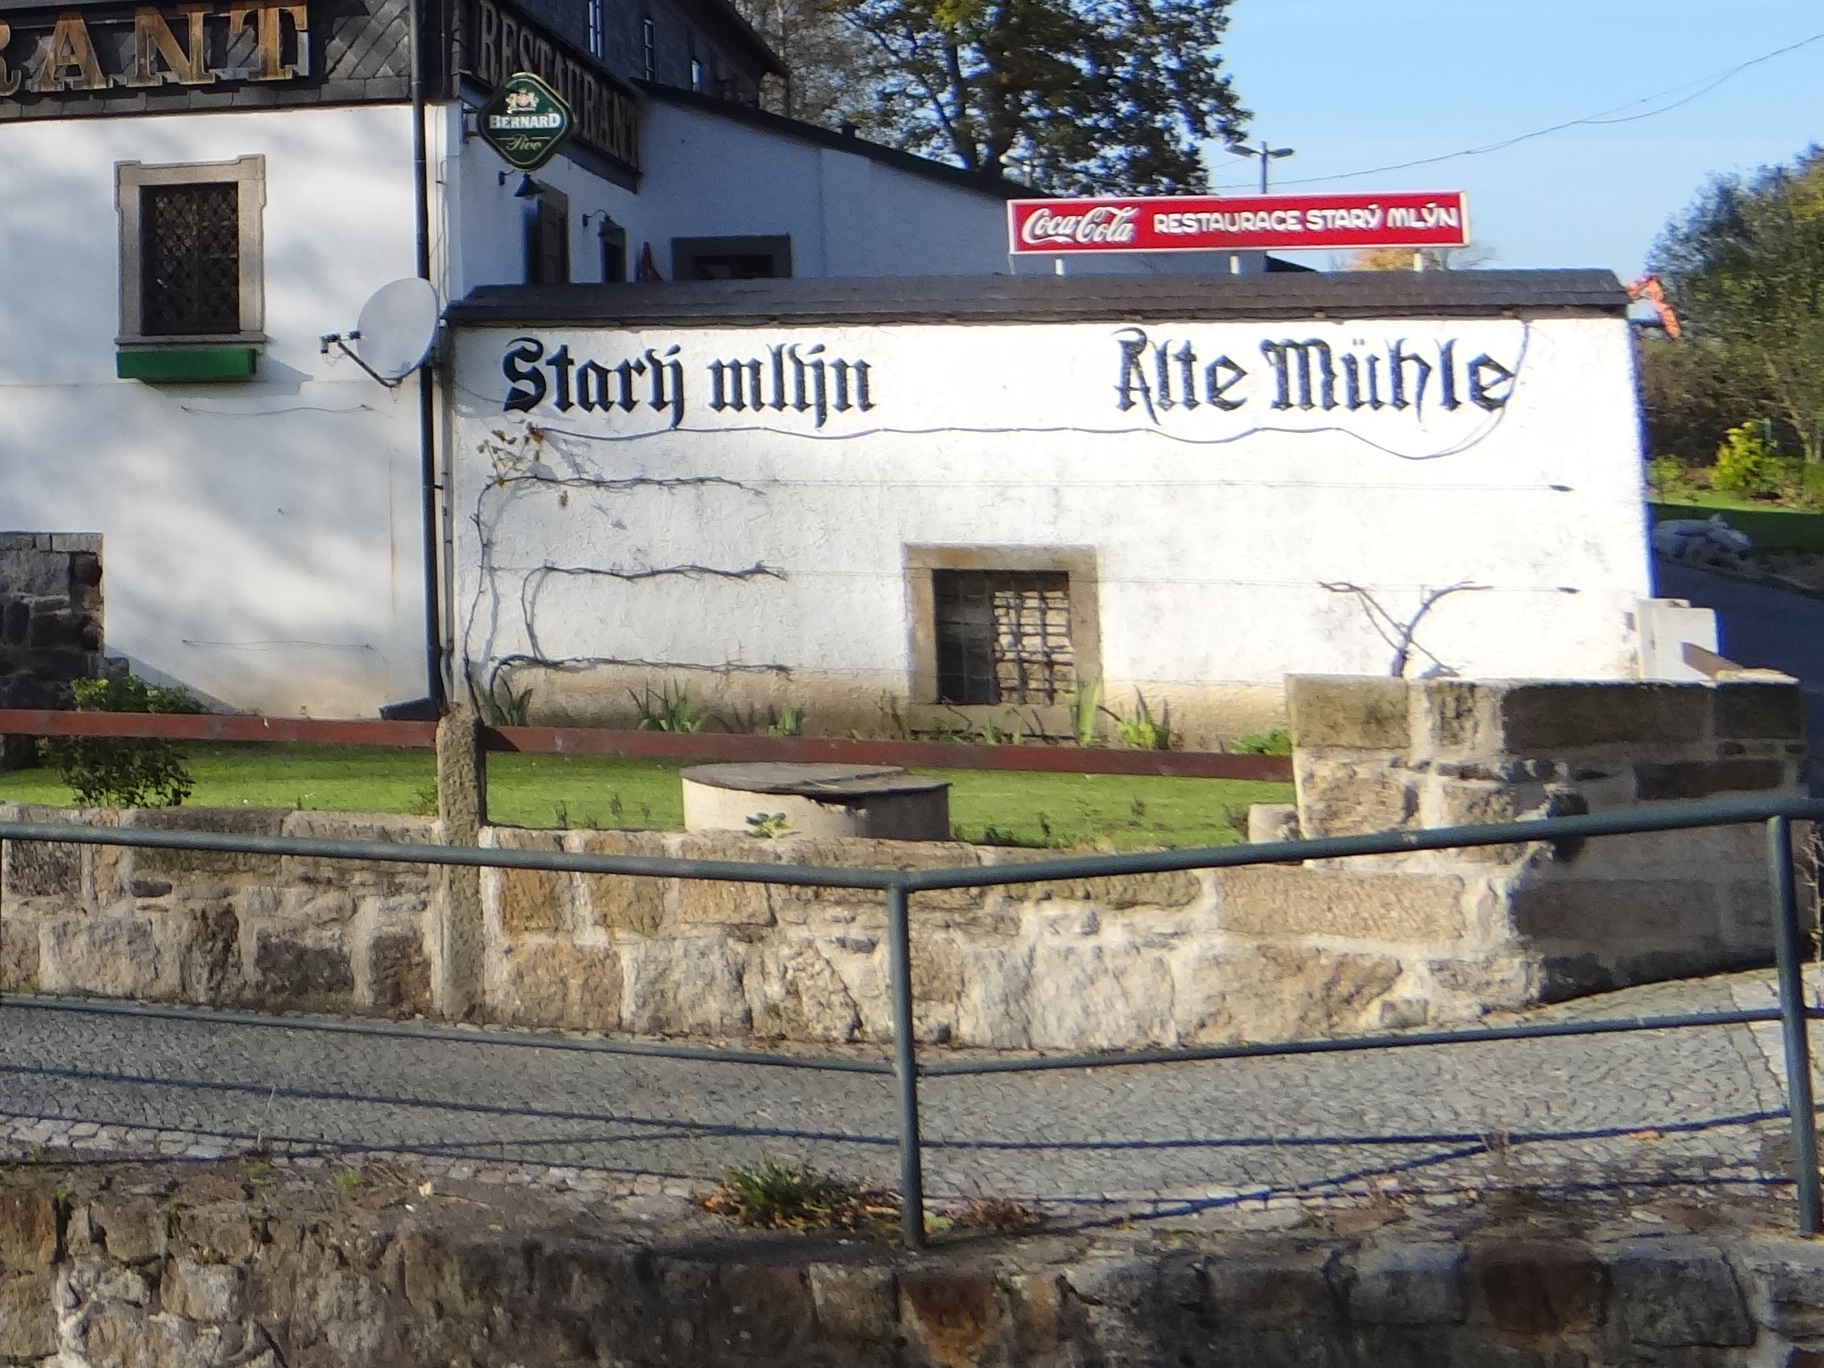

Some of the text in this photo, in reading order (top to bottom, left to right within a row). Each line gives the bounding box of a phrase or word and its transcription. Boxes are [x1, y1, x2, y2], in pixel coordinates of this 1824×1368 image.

[488, 113, 561, 129] BERNARD
[505, 134, 542, 151] Pivo
[1153, 211, 1302, 234] RESTAURACE
[1305, 204, 1382, 230] STARÝ
[1386, 202, 1459, 228] MLÝN
[502, 336, 685, 429] Starý
[1110, 327, 1516, 427] Alte Mühle
